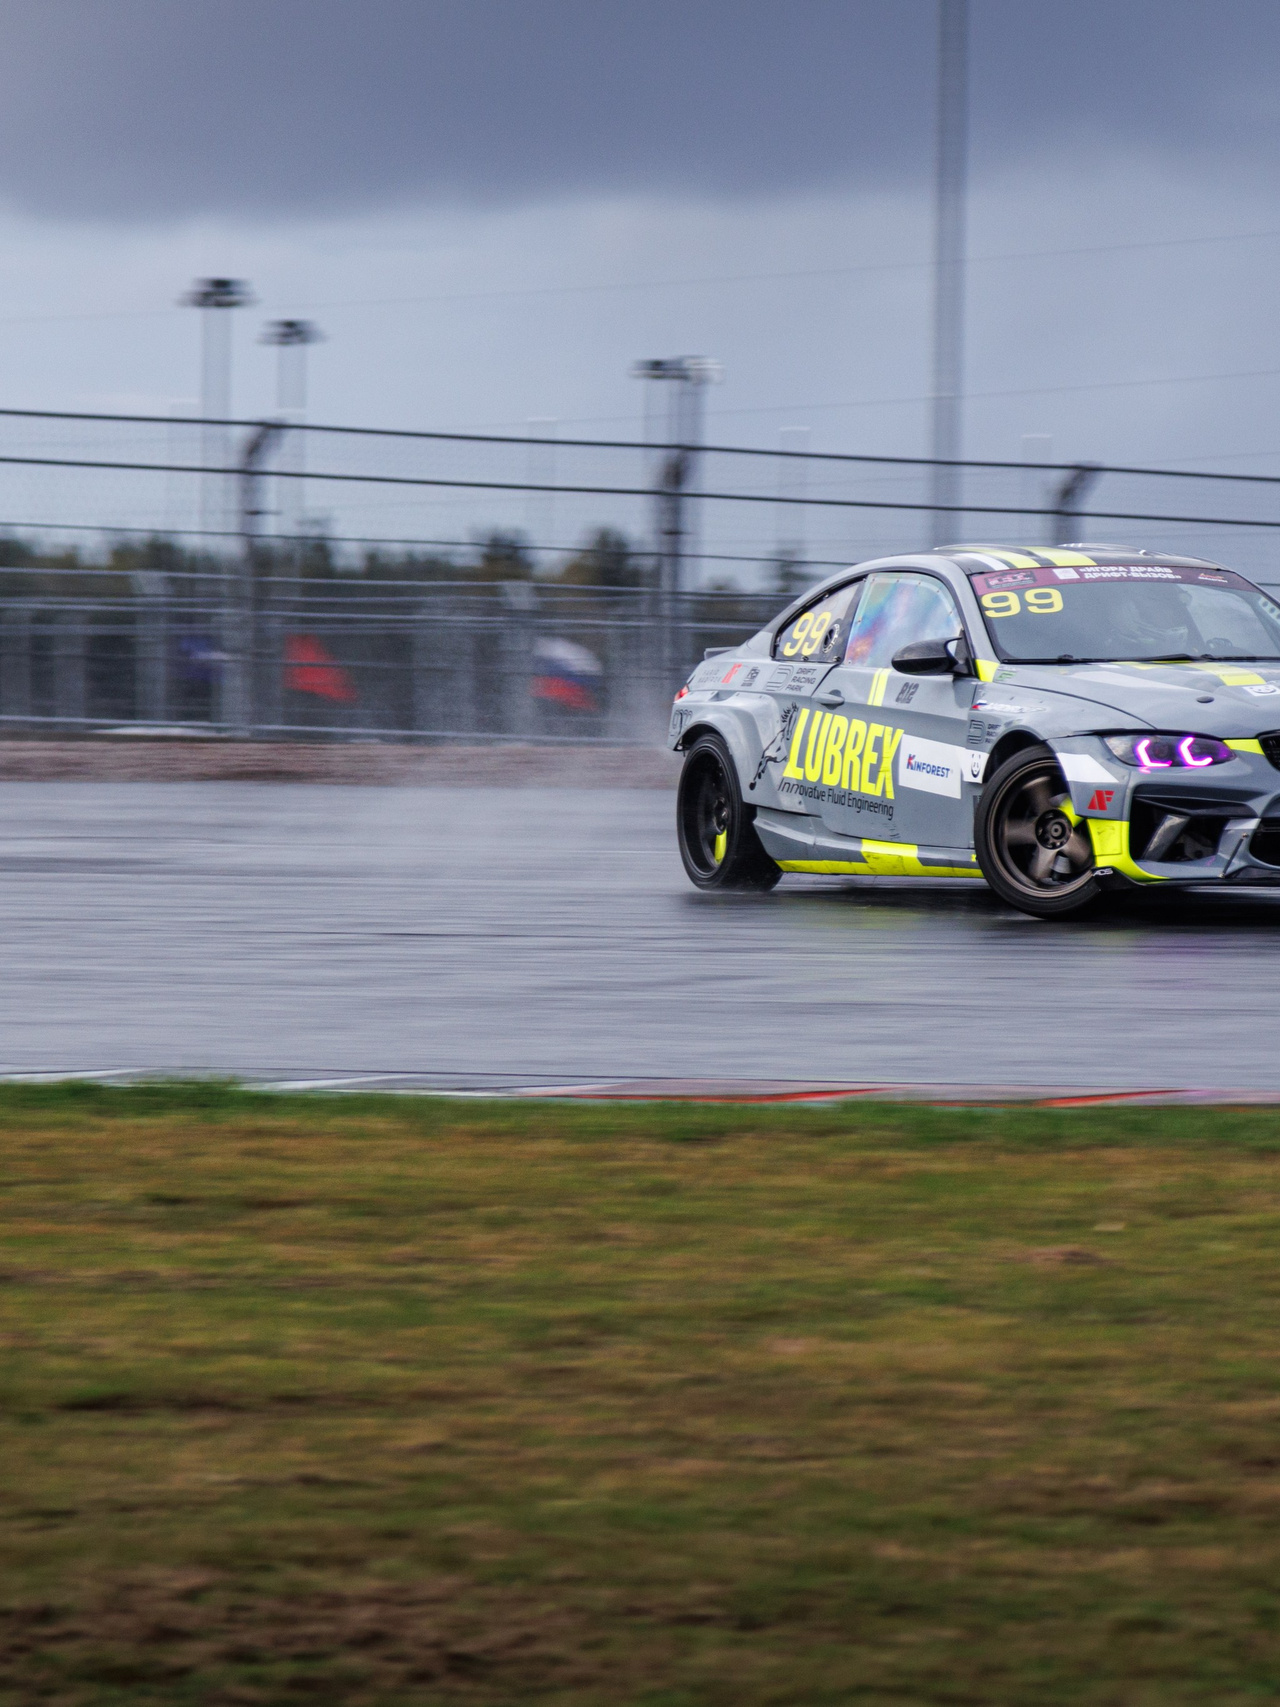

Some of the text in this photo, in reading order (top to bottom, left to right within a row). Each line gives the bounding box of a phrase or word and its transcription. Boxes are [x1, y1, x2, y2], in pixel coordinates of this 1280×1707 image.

[981, 588, 1064, 618] 99
[783, 611, 832, 657] 99
[782, 707, 905, 800] LUBREX
[906, 753, 951, 779] KINFOREST
[827, 788, 847, 807] Fluid
[847, 792, 895, 821] Engineering
